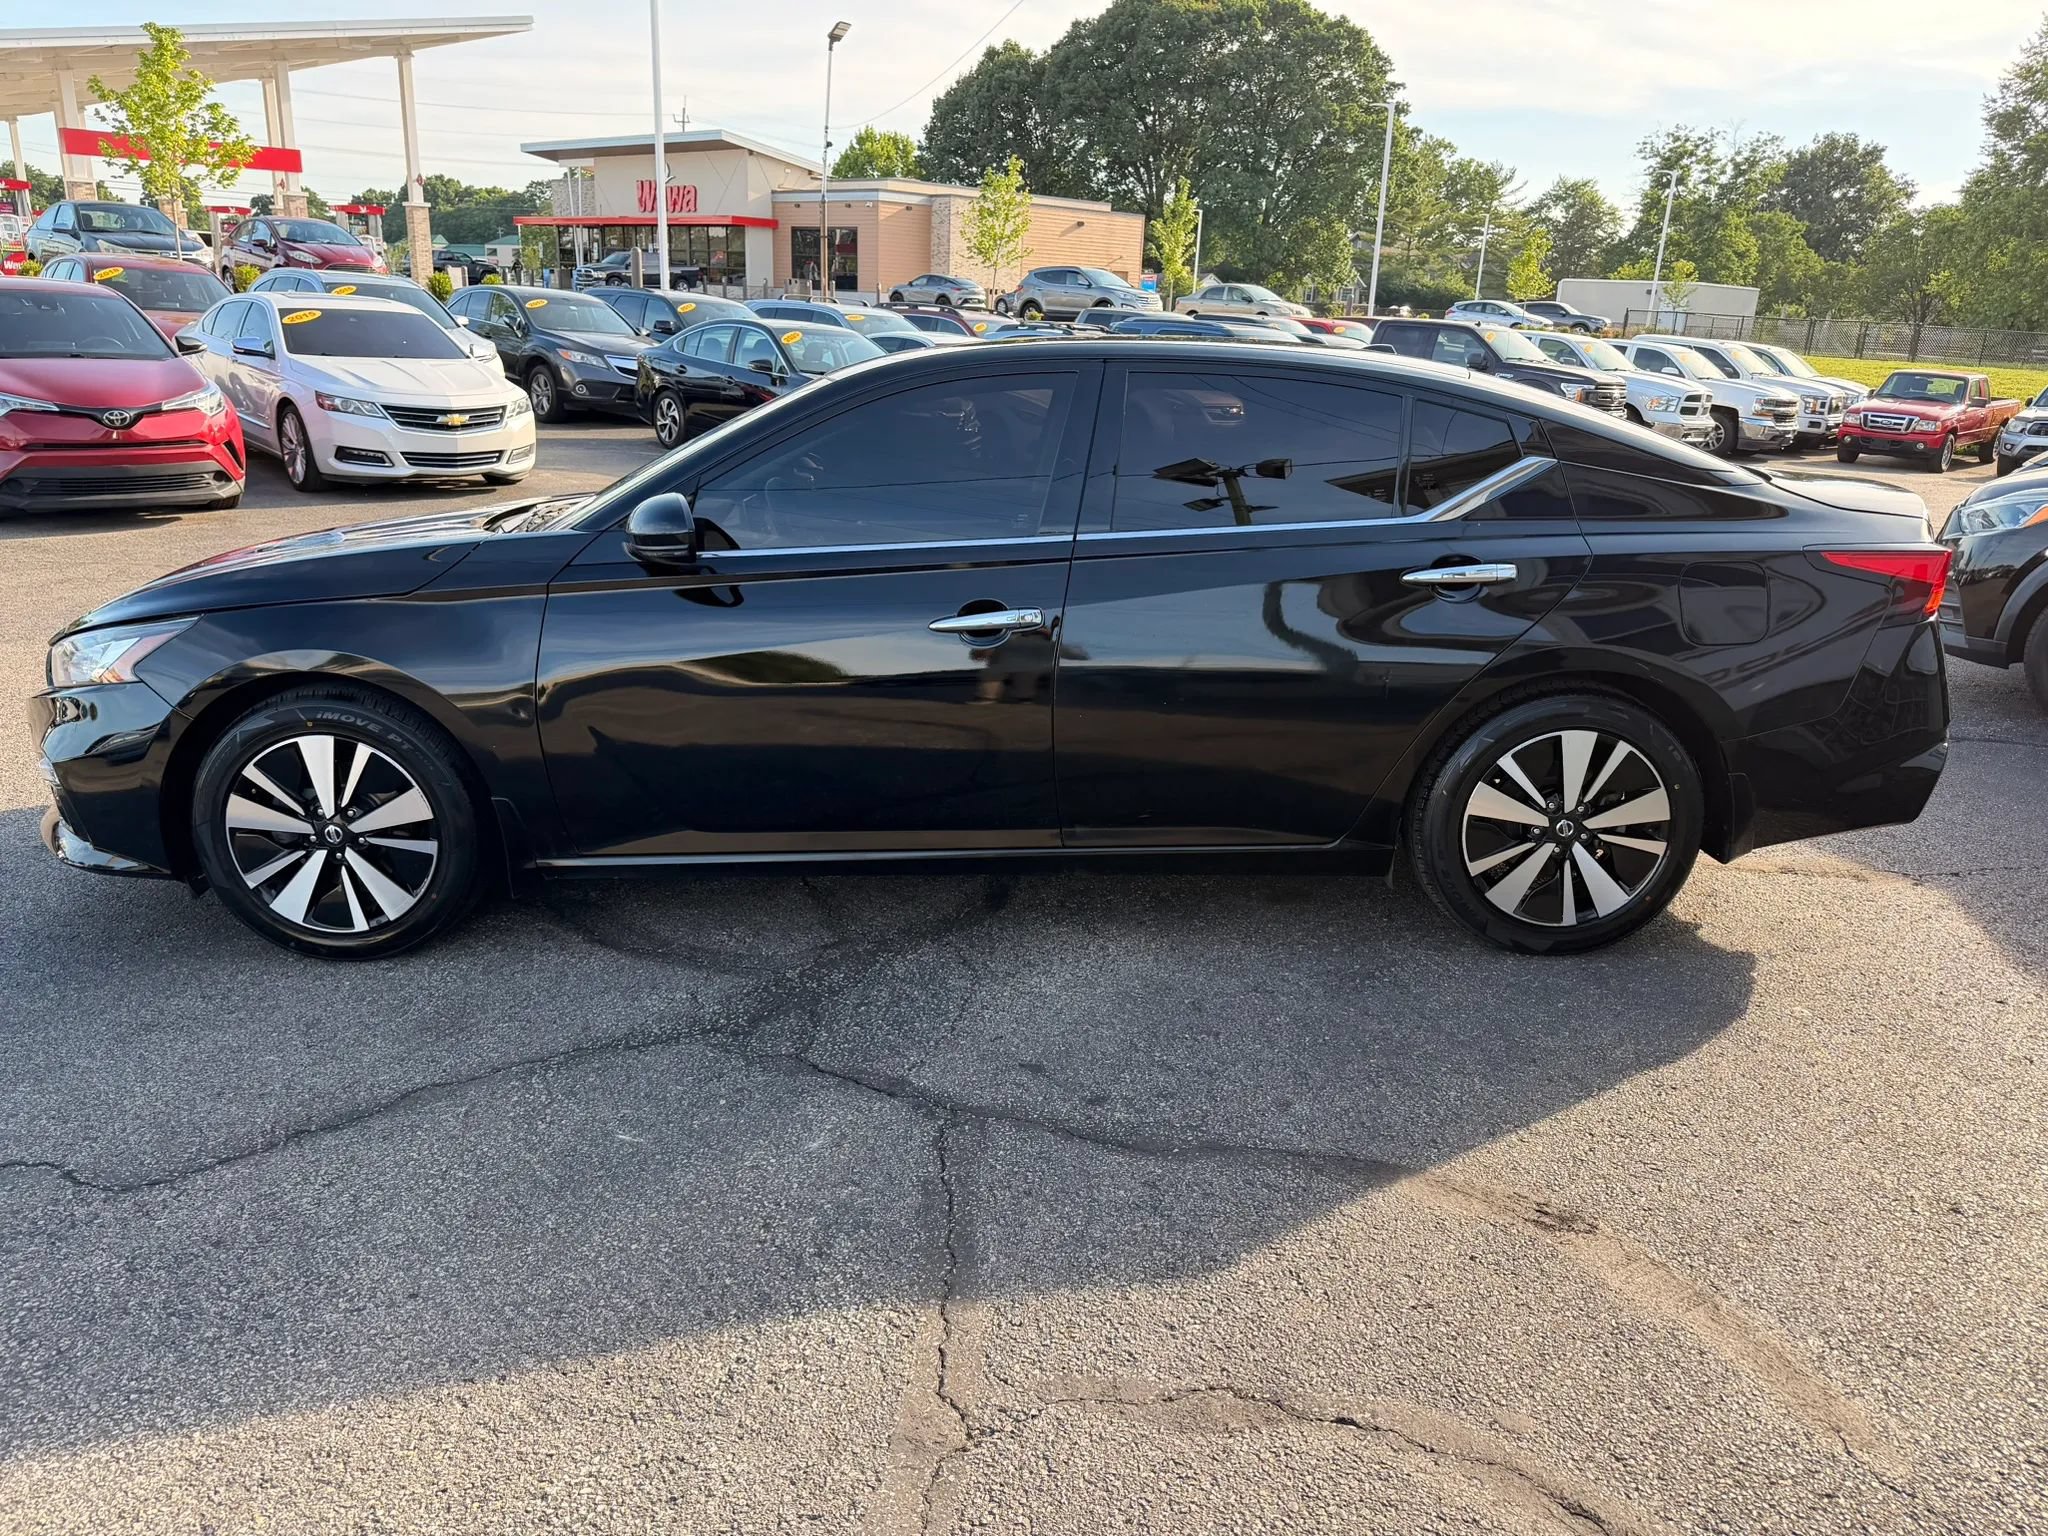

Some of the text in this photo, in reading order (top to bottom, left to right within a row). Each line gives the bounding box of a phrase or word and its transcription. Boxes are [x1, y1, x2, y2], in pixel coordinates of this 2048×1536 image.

[636, 180, 697, 212] Wwa
[288, 311, 316, 322] 2015
[316, 711, 414, 750] iMOVE PT
